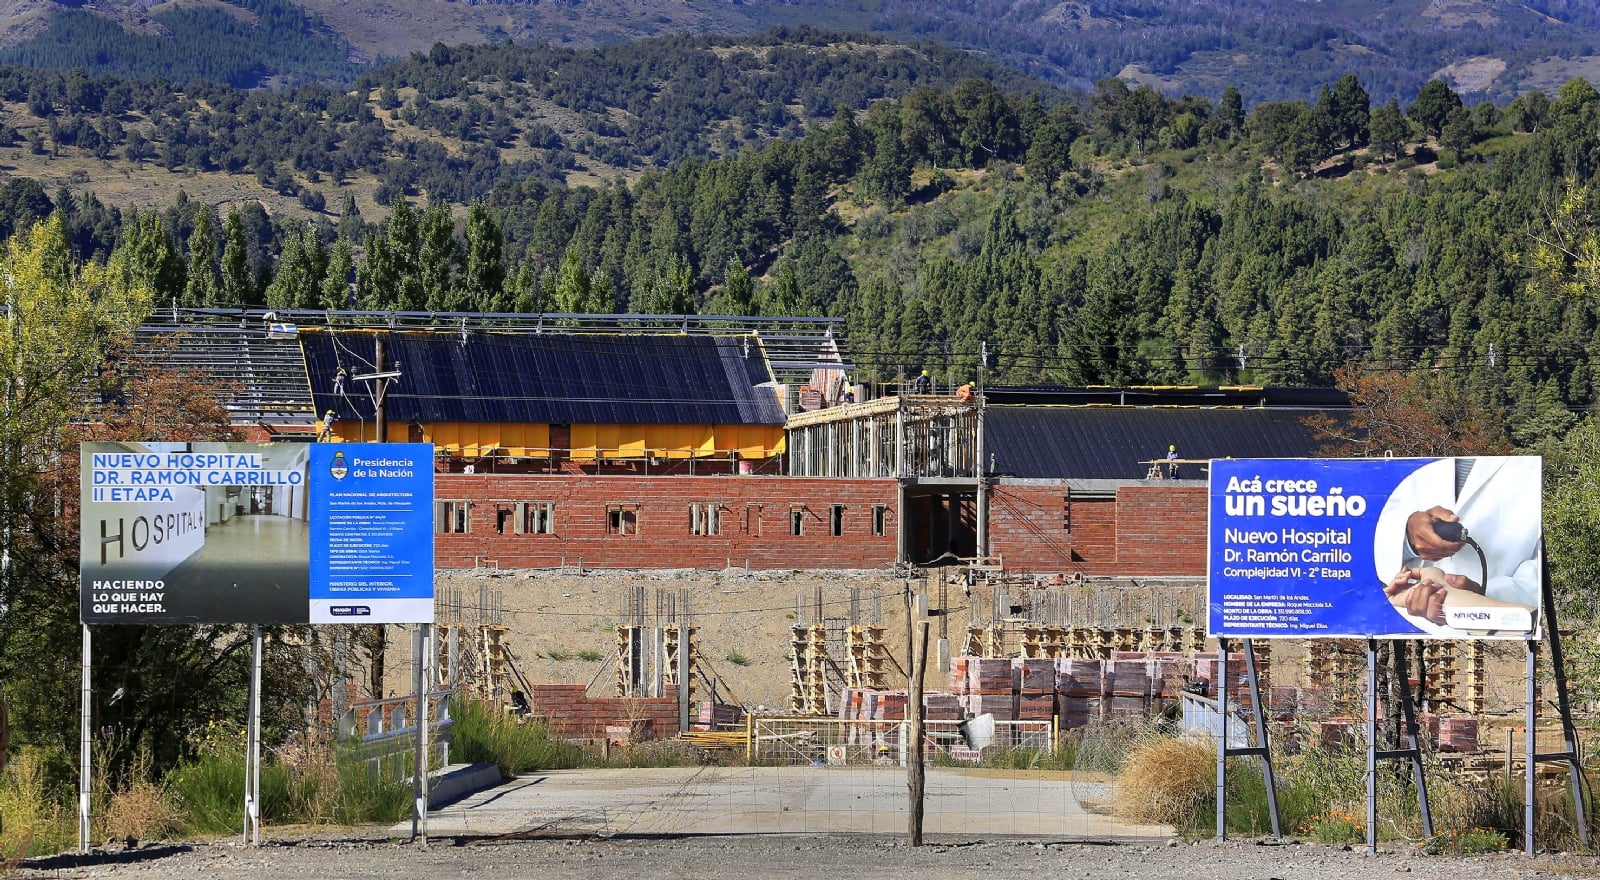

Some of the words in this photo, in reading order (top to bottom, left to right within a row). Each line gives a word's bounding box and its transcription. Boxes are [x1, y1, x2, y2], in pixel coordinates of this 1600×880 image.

[93, 454, 160, 468] NUEVO
[167, 454, 261, 468] HOSPITAL
[353, 458, 414, 467] Presidencia
[93, 471, 124, 485] DR.
[131, 468, 201, 485] RAMÓN
[207, 471, 302, 485] CARRILLO
[353, 469, 366, 478] de
[368, 469, 377, 478] la
[379, 469, 413, 478] Nación
[1225, 475, 1262, 493] Acá
[1265, 479, 1318, 493] crece
[93, 488, 104, 501] II
[111, 488, 174, 501] ETAPA
[1225, 495, 1265, 517] un
[1270, 487, 1366, 517] sueño
[100, 512, 198, 565] HOSPITAL
[1224, 528, 1278, 544] Nuevo
[1282, 528, 1351, 548] Hospital
[1224, 549, 1243, 563] Dr.
[1247, 549, 1298, 563] Ramón
[1301, 549, 1352, 563] Carrillo
[1224, 567, 1288, 580] Complejidad
[1290, 567, 1301, 578] VI
[1321, 568, 1351, 580] Etapa
[93, 580, 165, 590] HACIENDO
[93, 593, 109, 602] LO
[111, 593, 137, 602] QUE
[140, 593, 165, 602] HAY
[93, 603, 118, 614] QUE
[120, 603, 166, 614] HACER.
